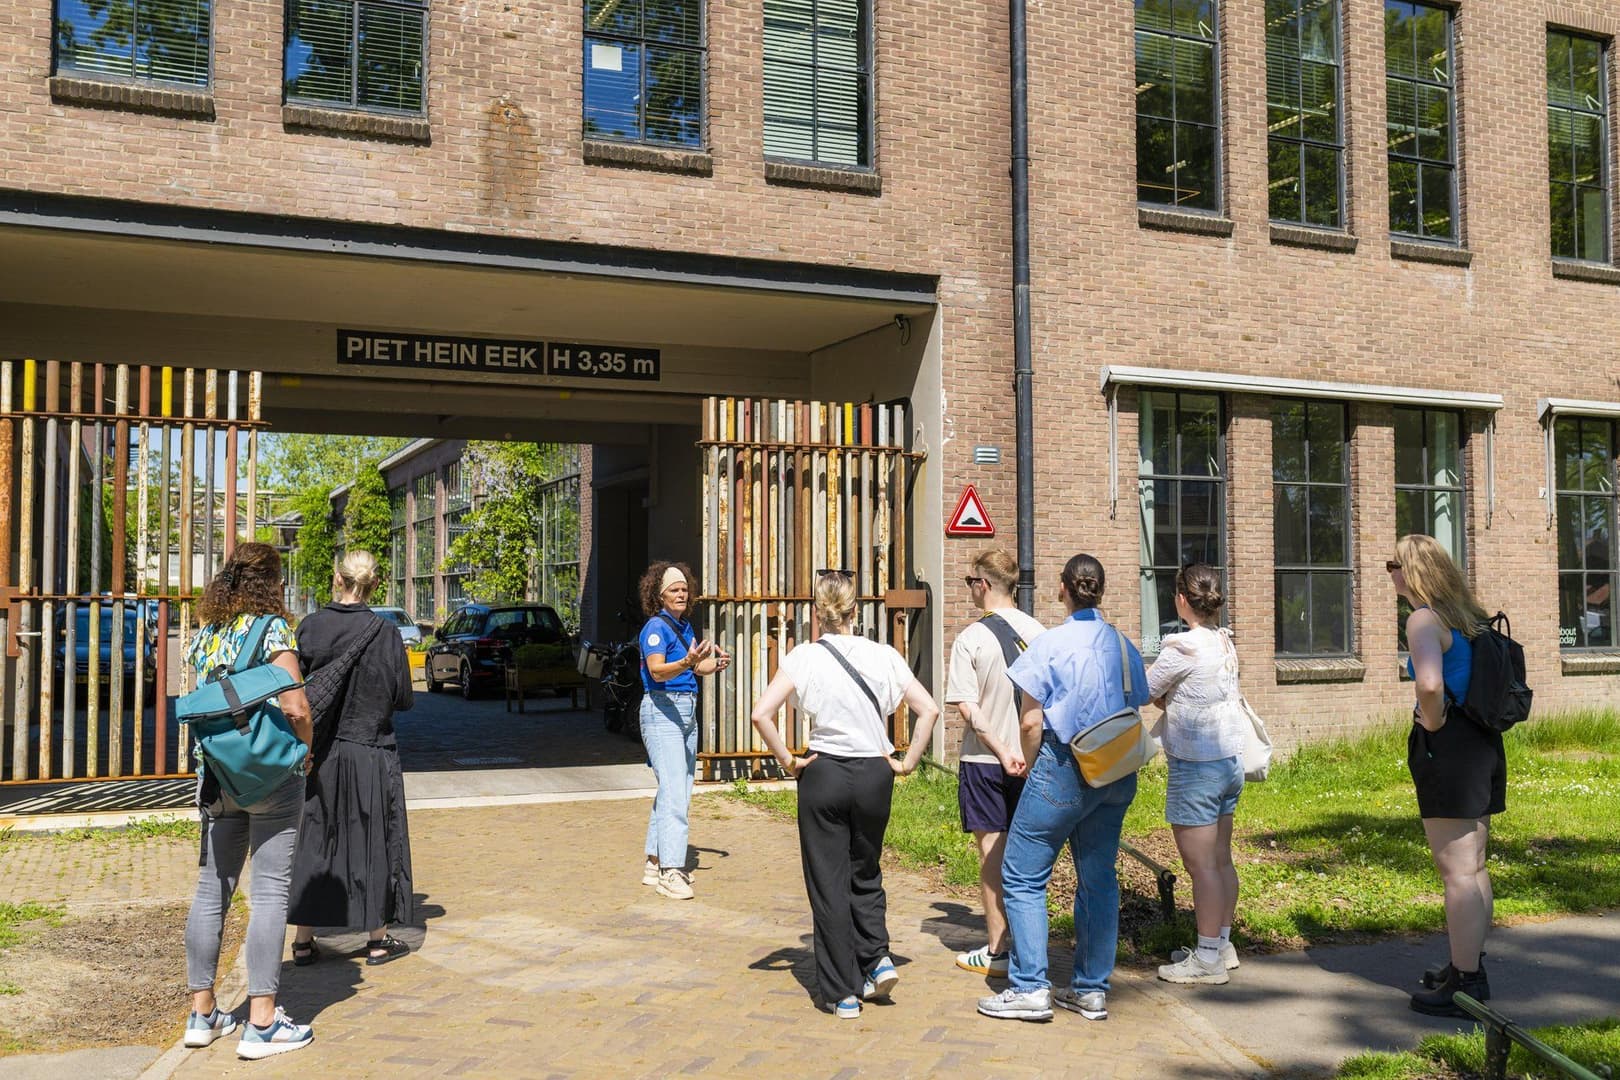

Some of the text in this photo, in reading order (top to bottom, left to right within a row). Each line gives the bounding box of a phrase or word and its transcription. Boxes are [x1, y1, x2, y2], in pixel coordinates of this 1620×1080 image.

[346, 336, 538, 369] PIET HEIN EEK
[553, 348, 655, 375] H 3,35 m
[1559, 627, 1577, 636] bout
[1559, 636, 1577, 647] oday
